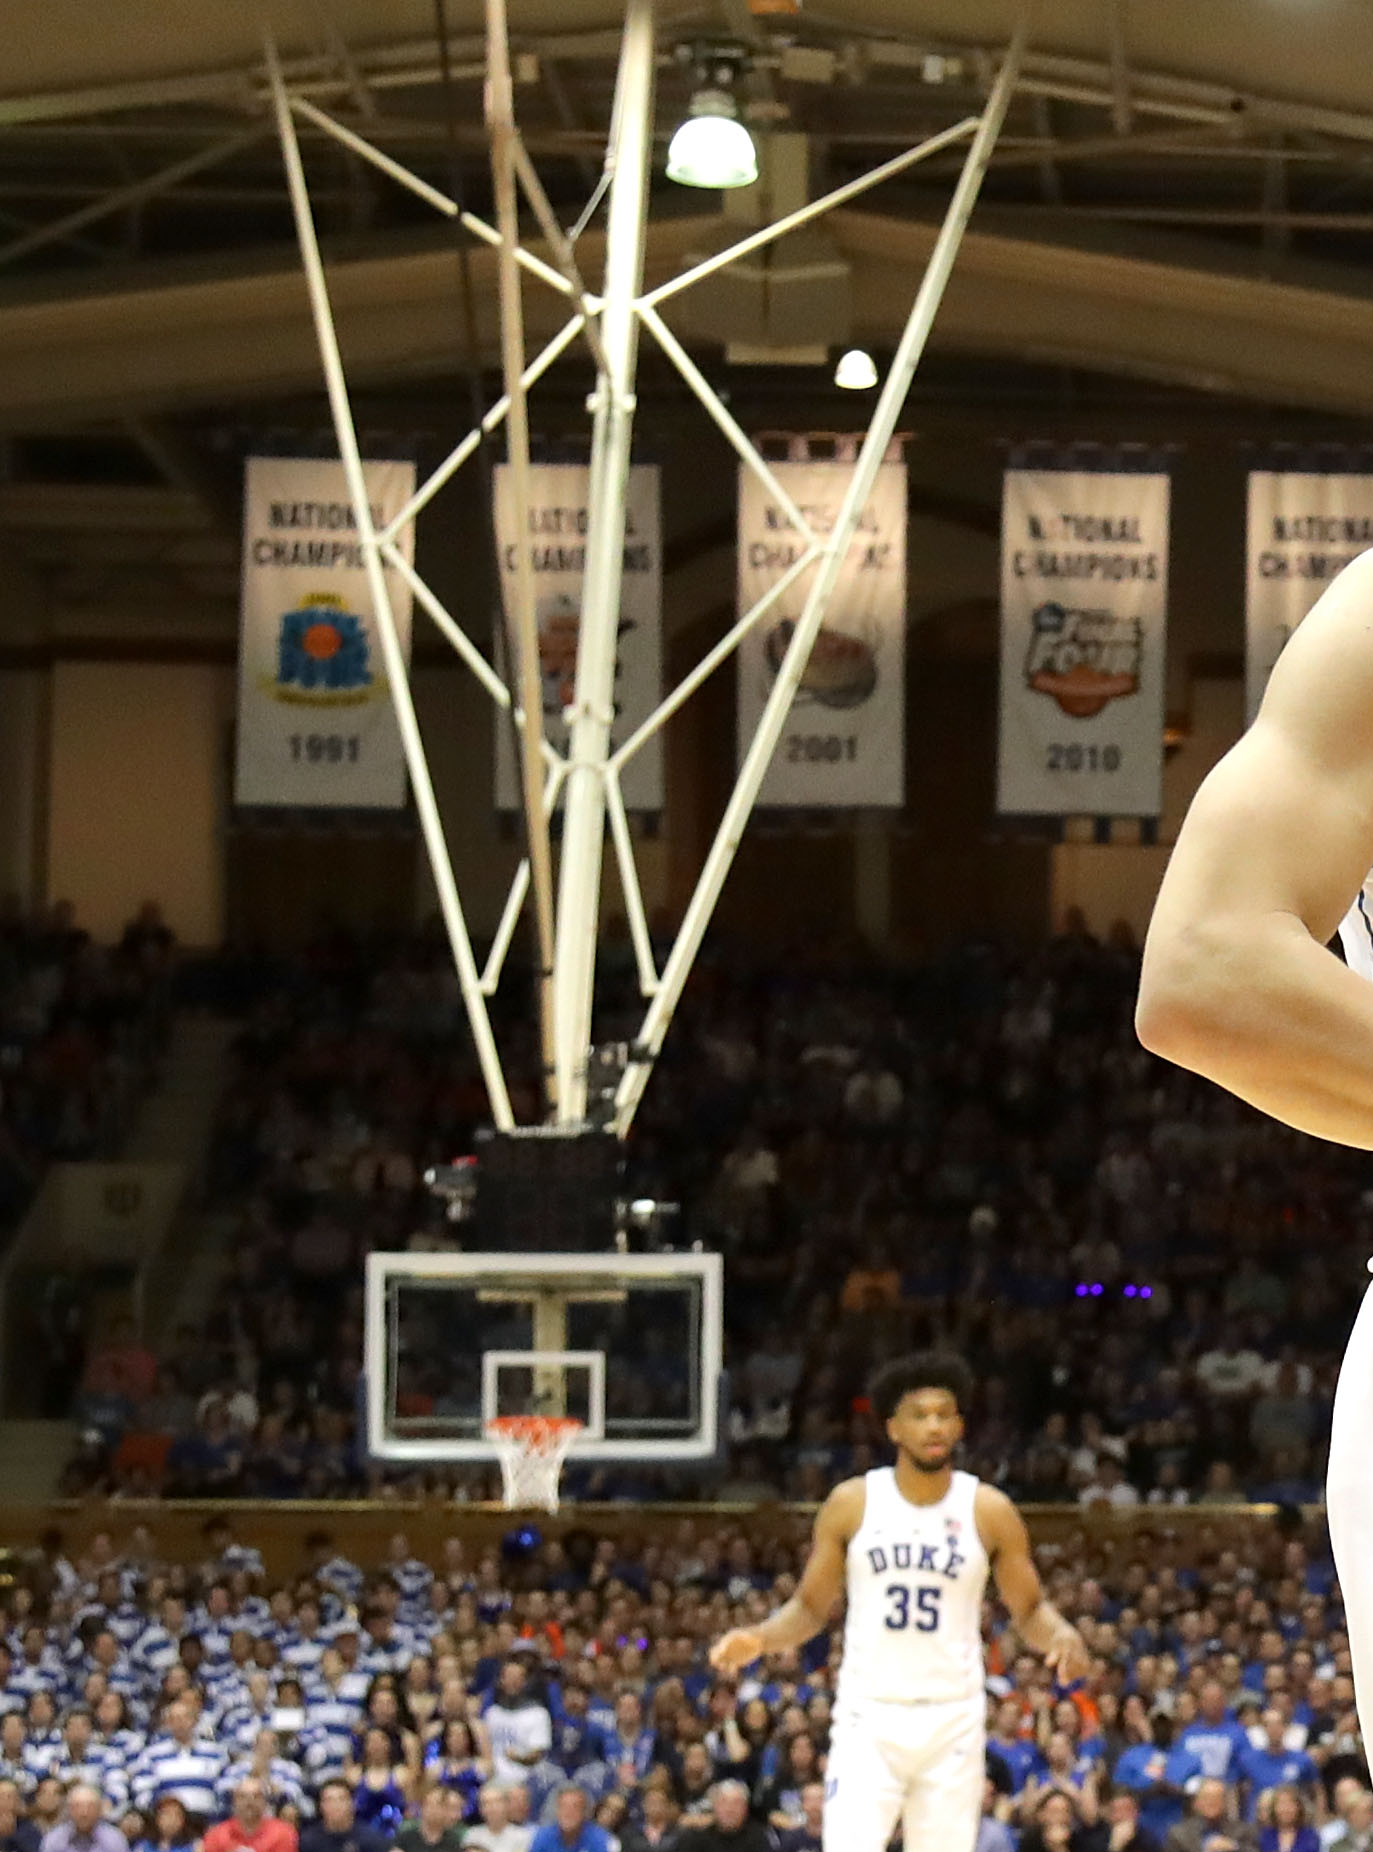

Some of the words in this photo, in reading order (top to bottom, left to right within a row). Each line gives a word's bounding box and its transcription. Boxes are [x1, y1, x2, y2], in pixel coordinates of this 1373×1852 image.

[1047, 743, 1121, 772] 2010
[867, 1542, 966, 1580] DUKE
[885, 1583, 943, 1634] 35
